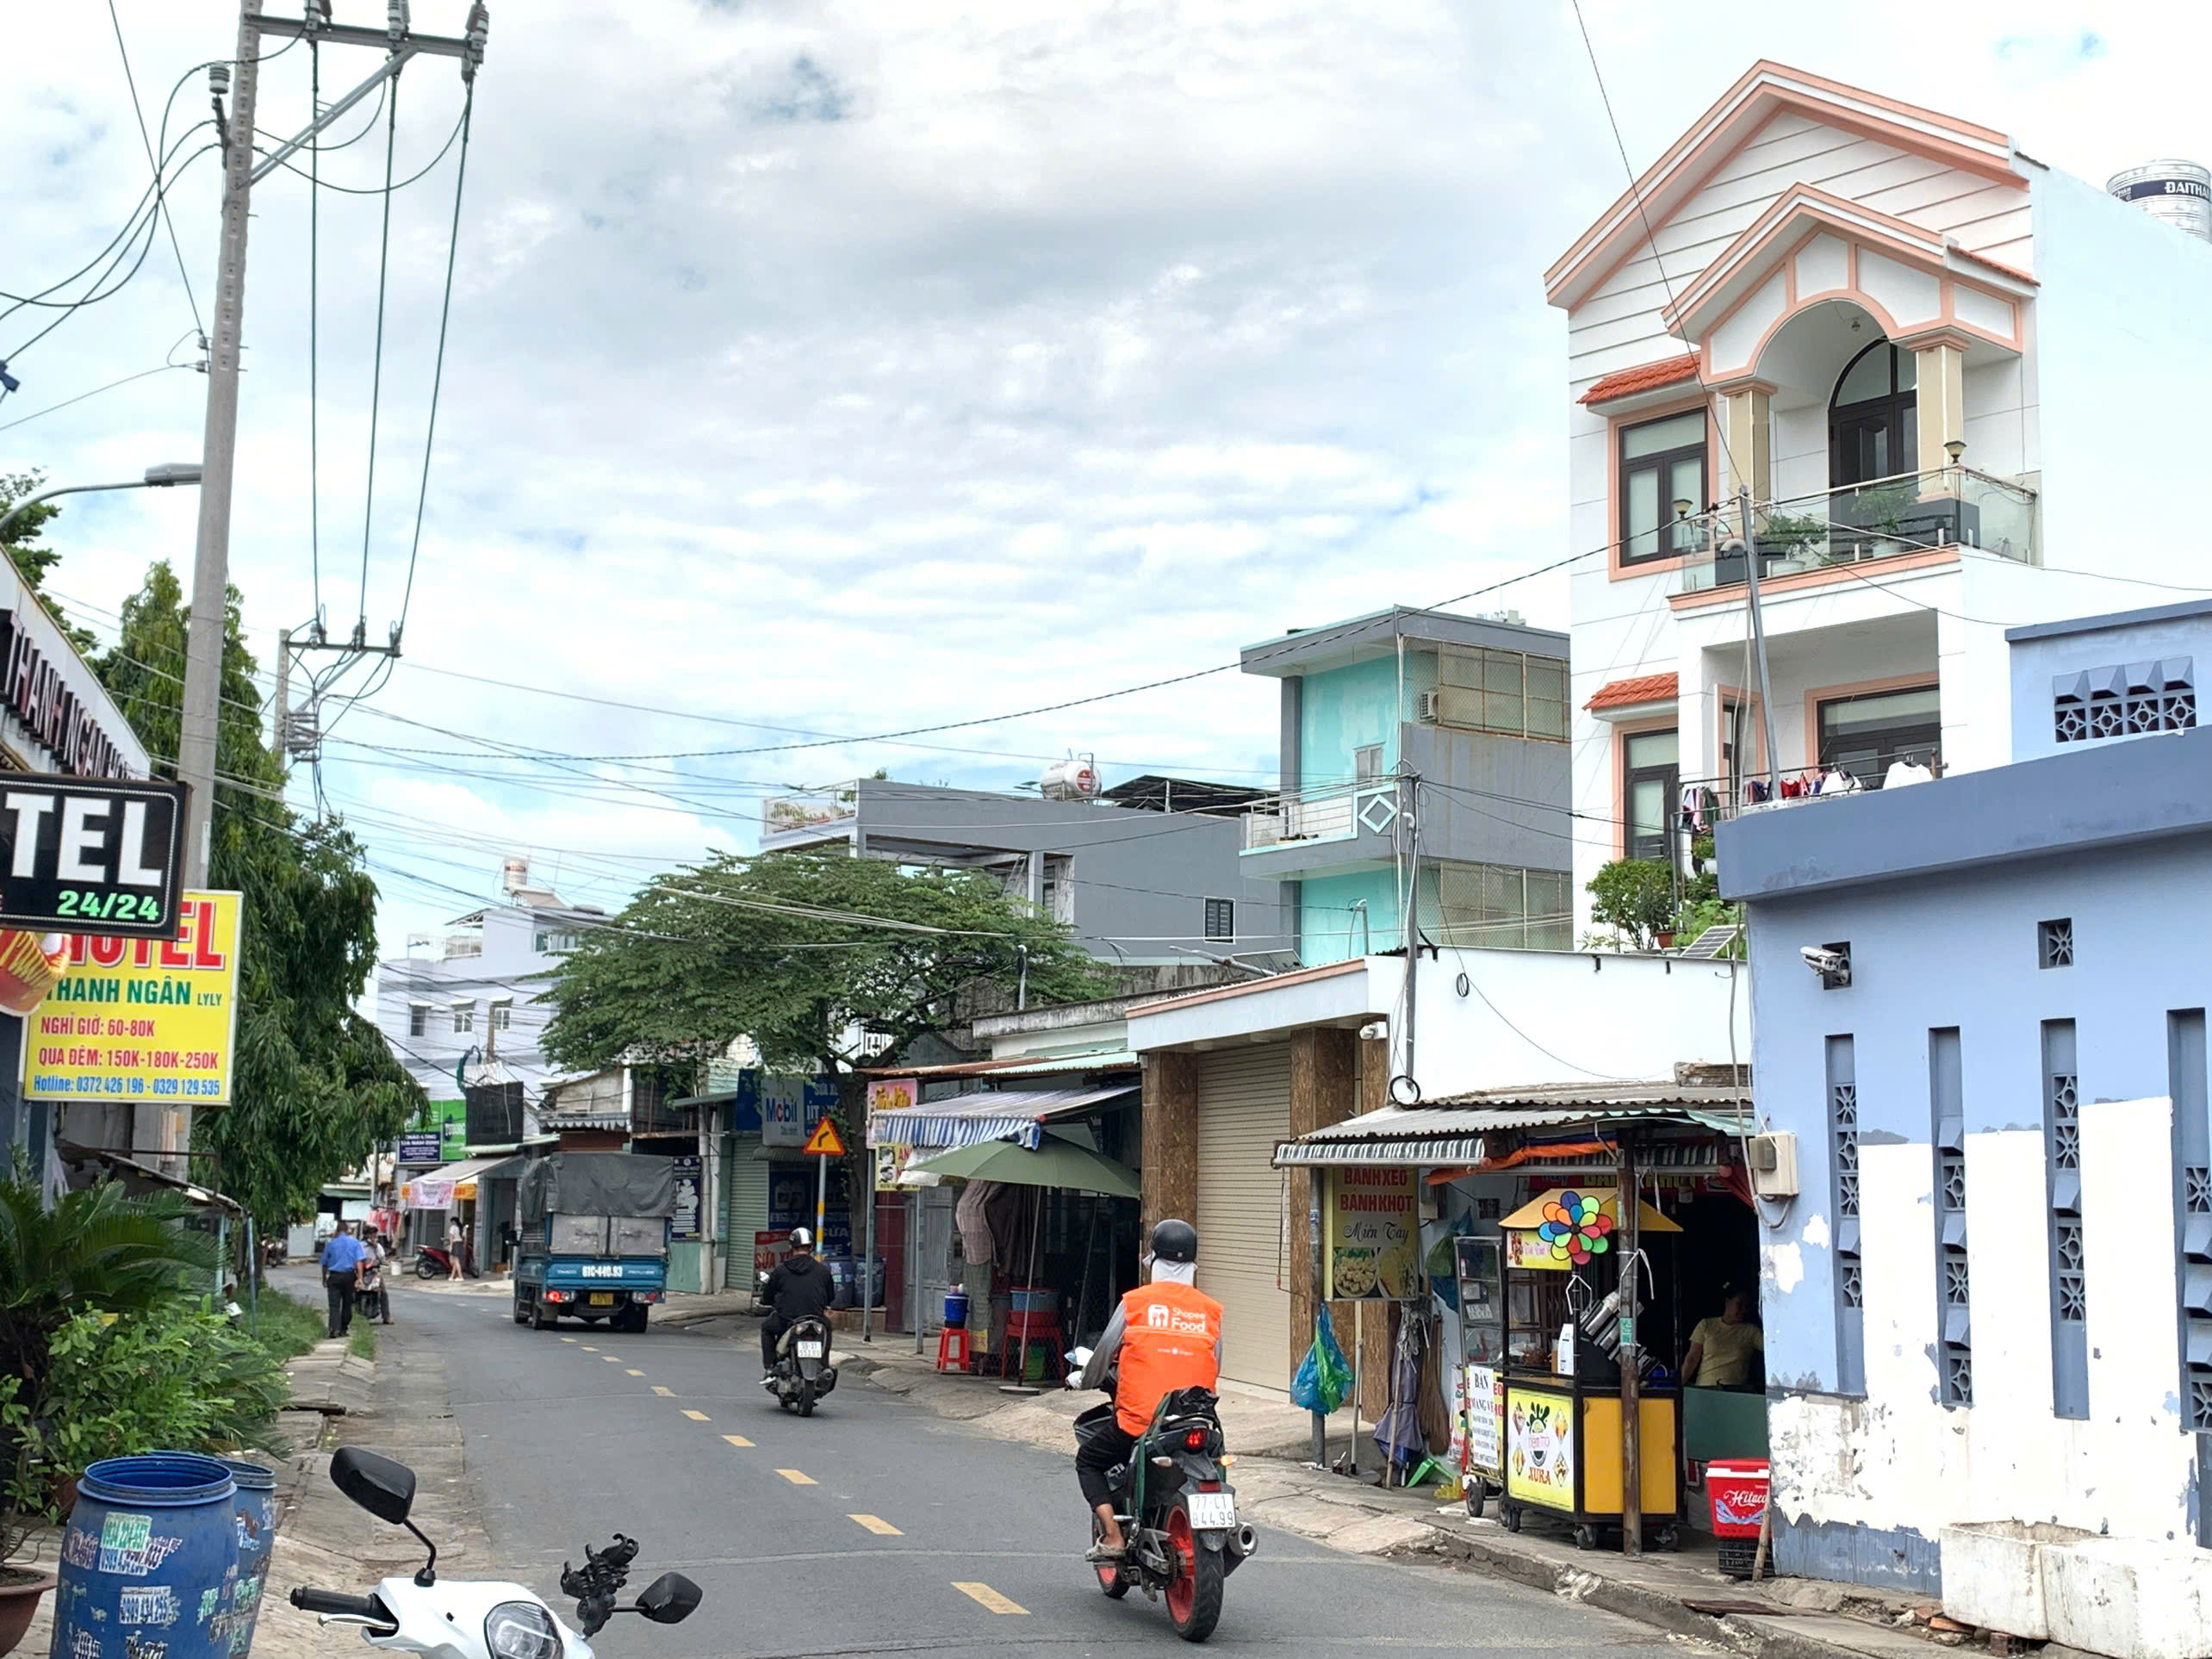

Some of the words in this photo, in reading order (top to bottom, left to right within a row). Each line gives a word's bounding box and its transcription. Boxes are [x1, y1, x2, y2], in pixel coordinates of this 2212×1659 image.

[5, 792, 163, 886] TEL
[57, 890, 159, 921] 24/24
[127, 975, 192, 1005] NGÂN
[196, 993, 223, 1006] LYLY
[40, 1011, 75, 1035] NGHỈ
[108, 1019, 156, 1037] 60-80K
[39, 1047, 65, 1066] QUA
[68, 1045, 103, 1066] ĐÊM:
[107, 1050, 219, 1069] 150K-180K-250K
[34, 1075, 74, 1091] Hotline:
[76, 1076, 103, 1093] 0372
[104, 1077, 123, 1093] 426
[126, 1078, 144, 1094] 196
[152, 1078, 178, 1095] 0329
[181, 1078, 200, 1096] 129
[201, 1079, 221, 1096] 535
[766, 1097, 798, 1122] Mobil
[1171, 1317, 1206, 1333] Food
[1192, 1511, 1234, 1526] 844.99
